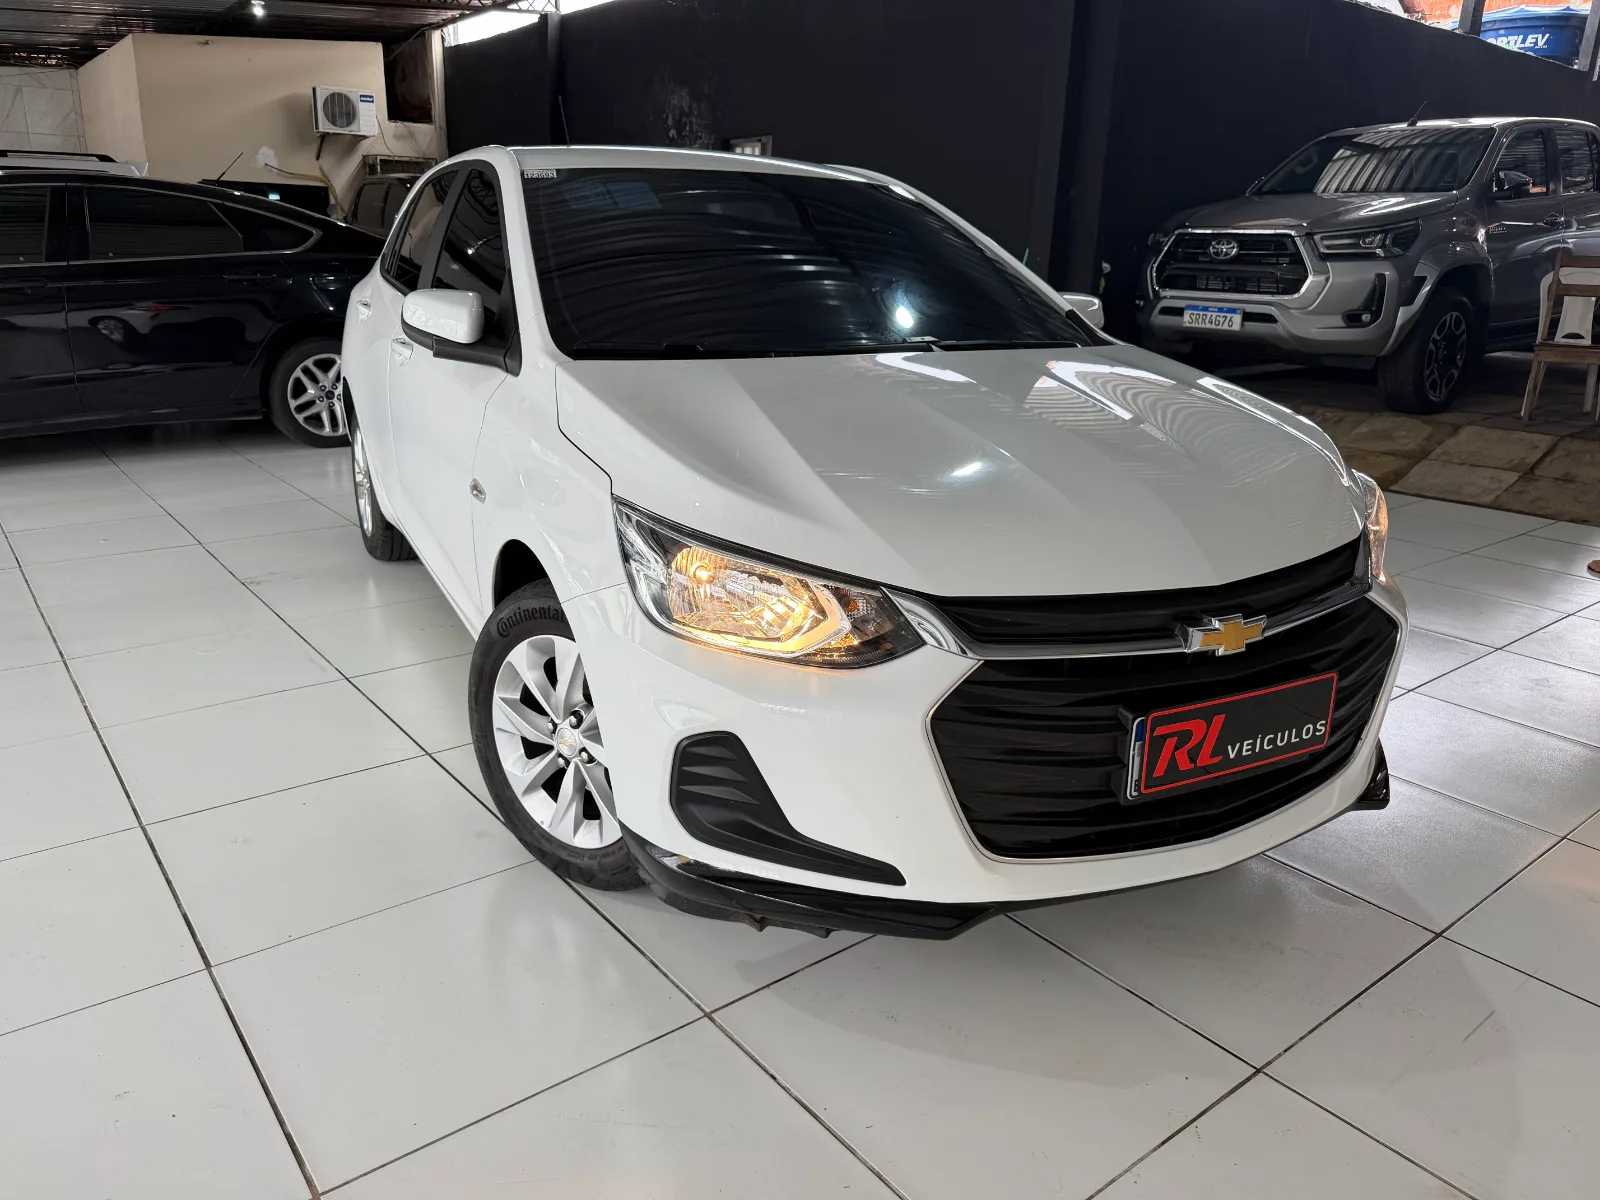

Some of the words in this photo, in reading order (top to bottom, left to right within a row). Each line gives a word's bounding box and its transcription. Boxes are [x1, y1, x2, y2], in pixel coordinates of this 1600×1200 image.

[1187, 312, 1234, 328] SRR4G76
[497, 605, 564, 638] Continental
[1153, 713, 1226, 778] RL
[1227, 720, 1326, 759] VEÍCULOS
